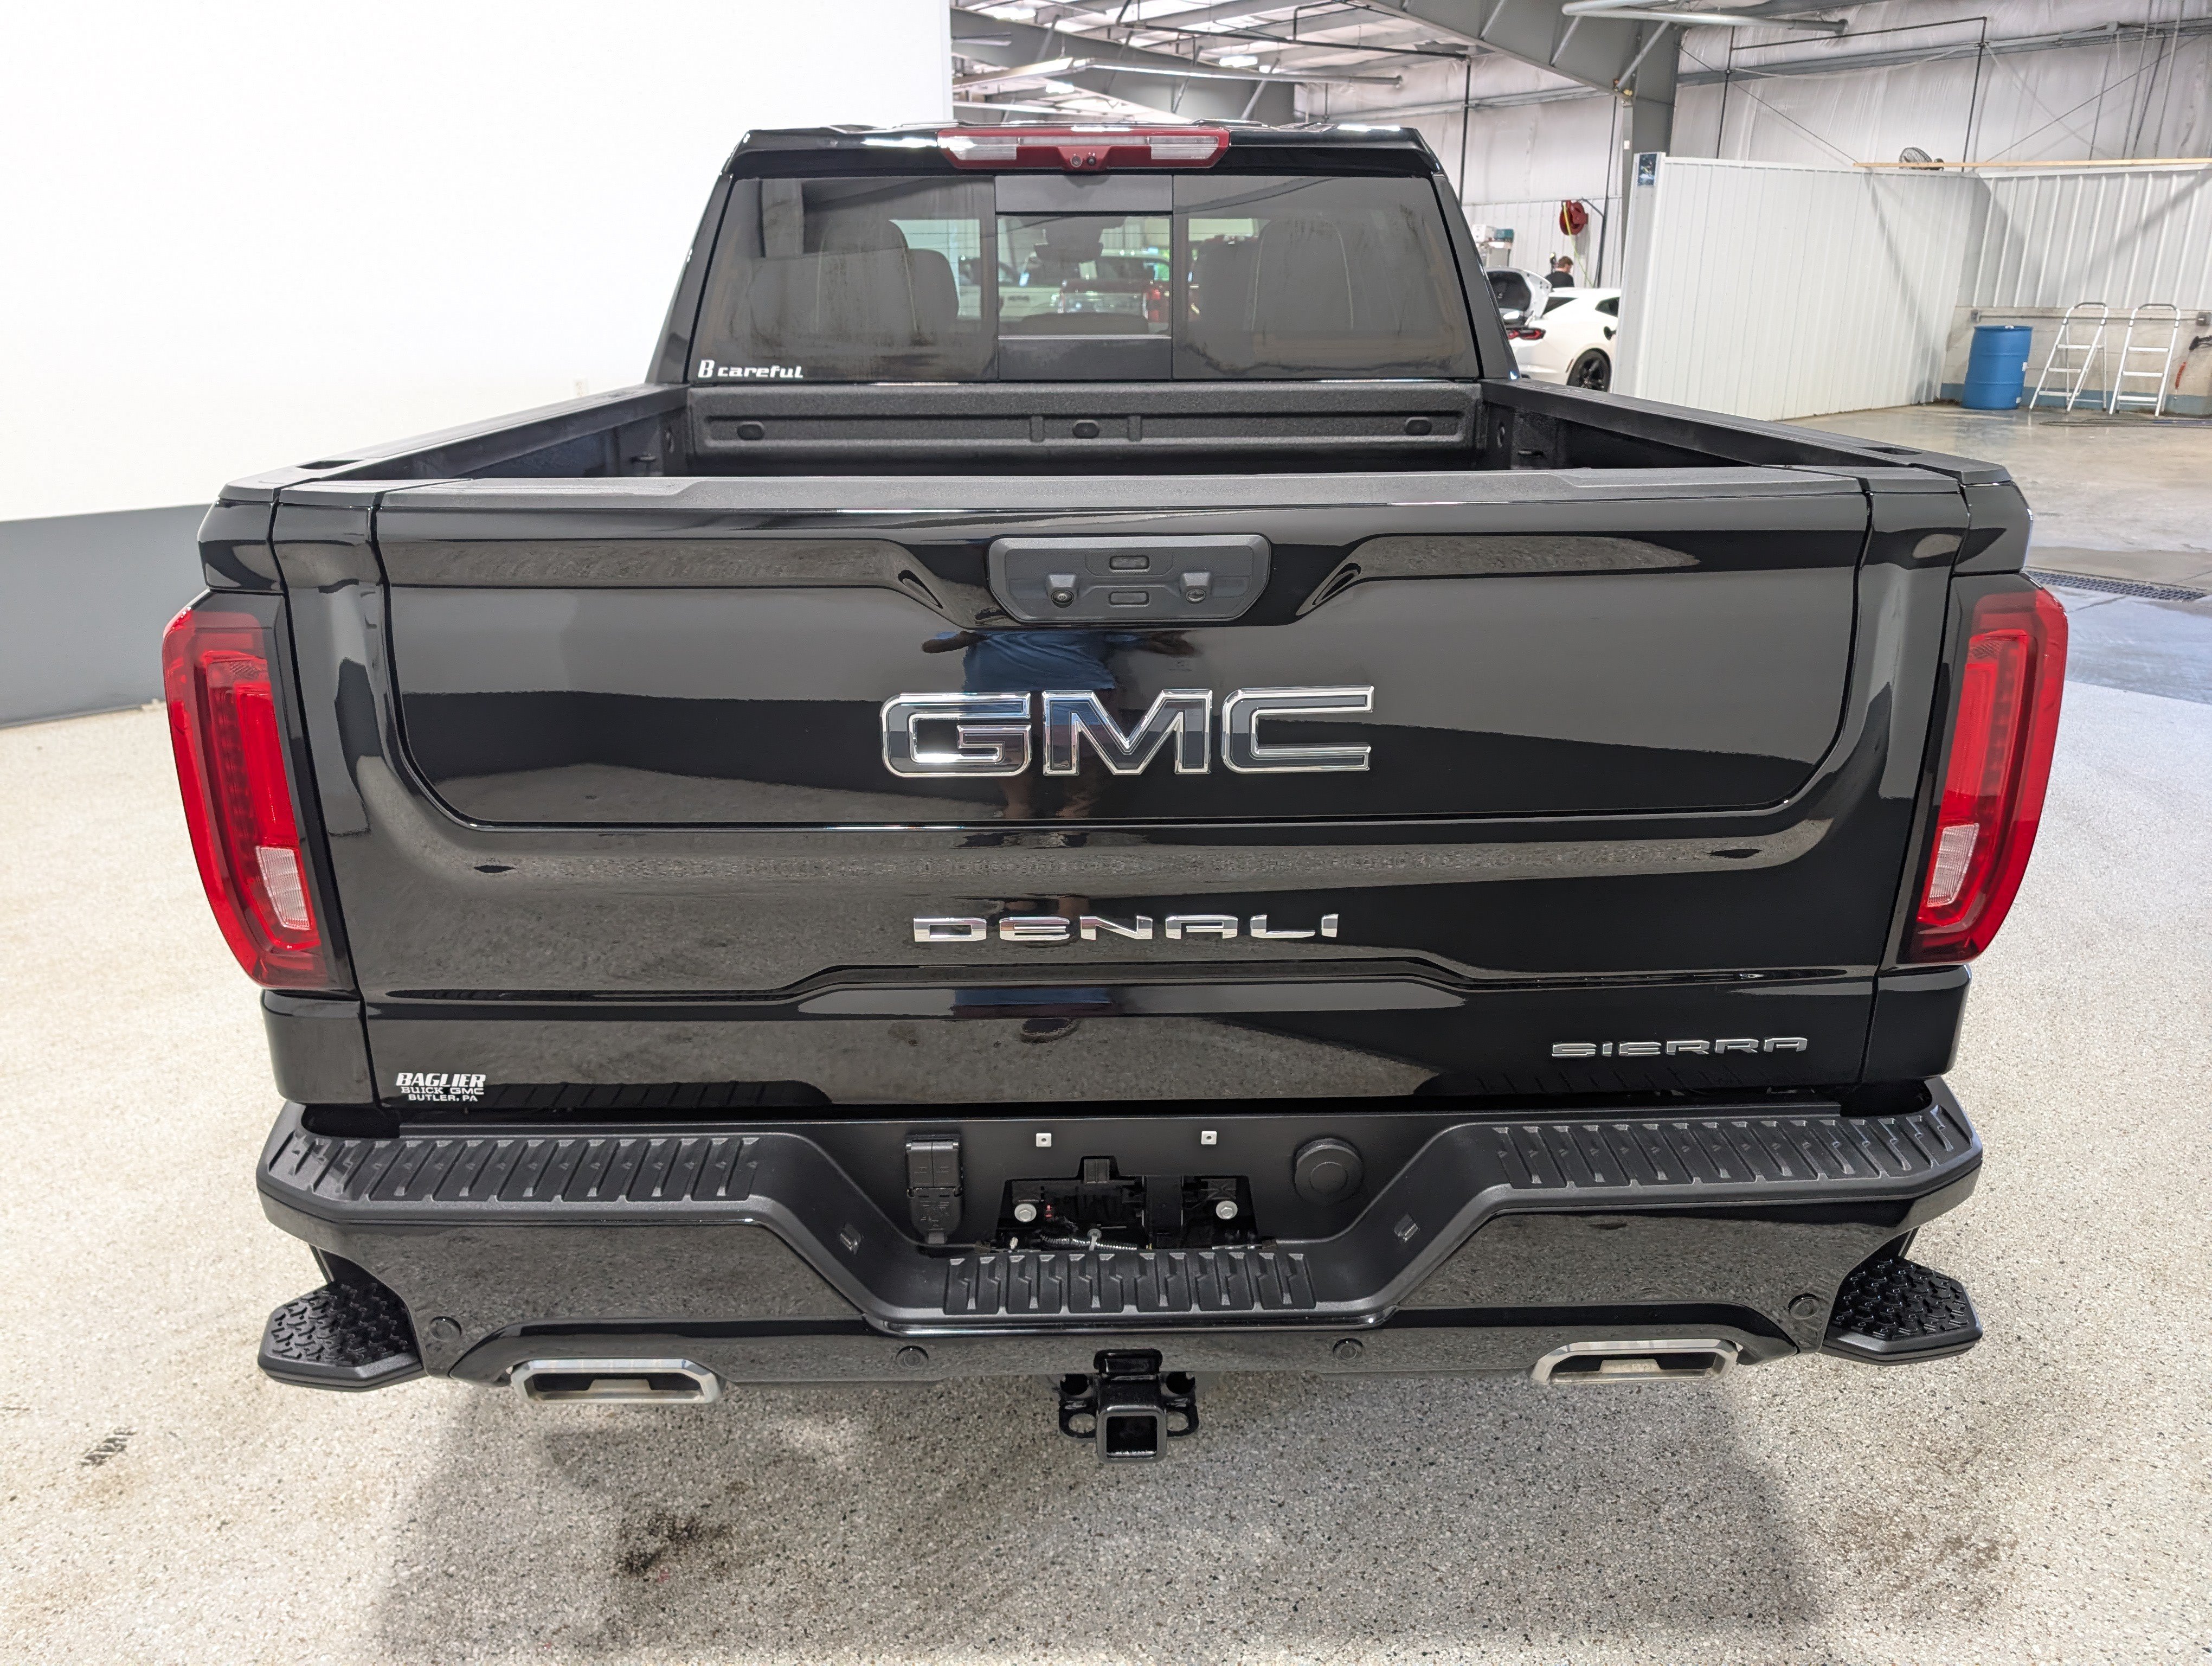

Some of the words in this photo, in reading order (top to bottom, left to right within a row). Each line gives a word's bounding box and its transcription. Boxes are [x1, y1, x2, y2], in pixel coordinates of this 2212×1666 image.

[698, 360, 715, 378] B
[717, 365, 803, 378] careful
[880, 685, 1374, 777] GMC
[913, 913, 1339, 943] DENALI
[1551, 1037, 1808, 1057] SIERRA
[395, 1072, 486, 1087] BAGLIER
[401, 1086, 444, 1094] BUICK
